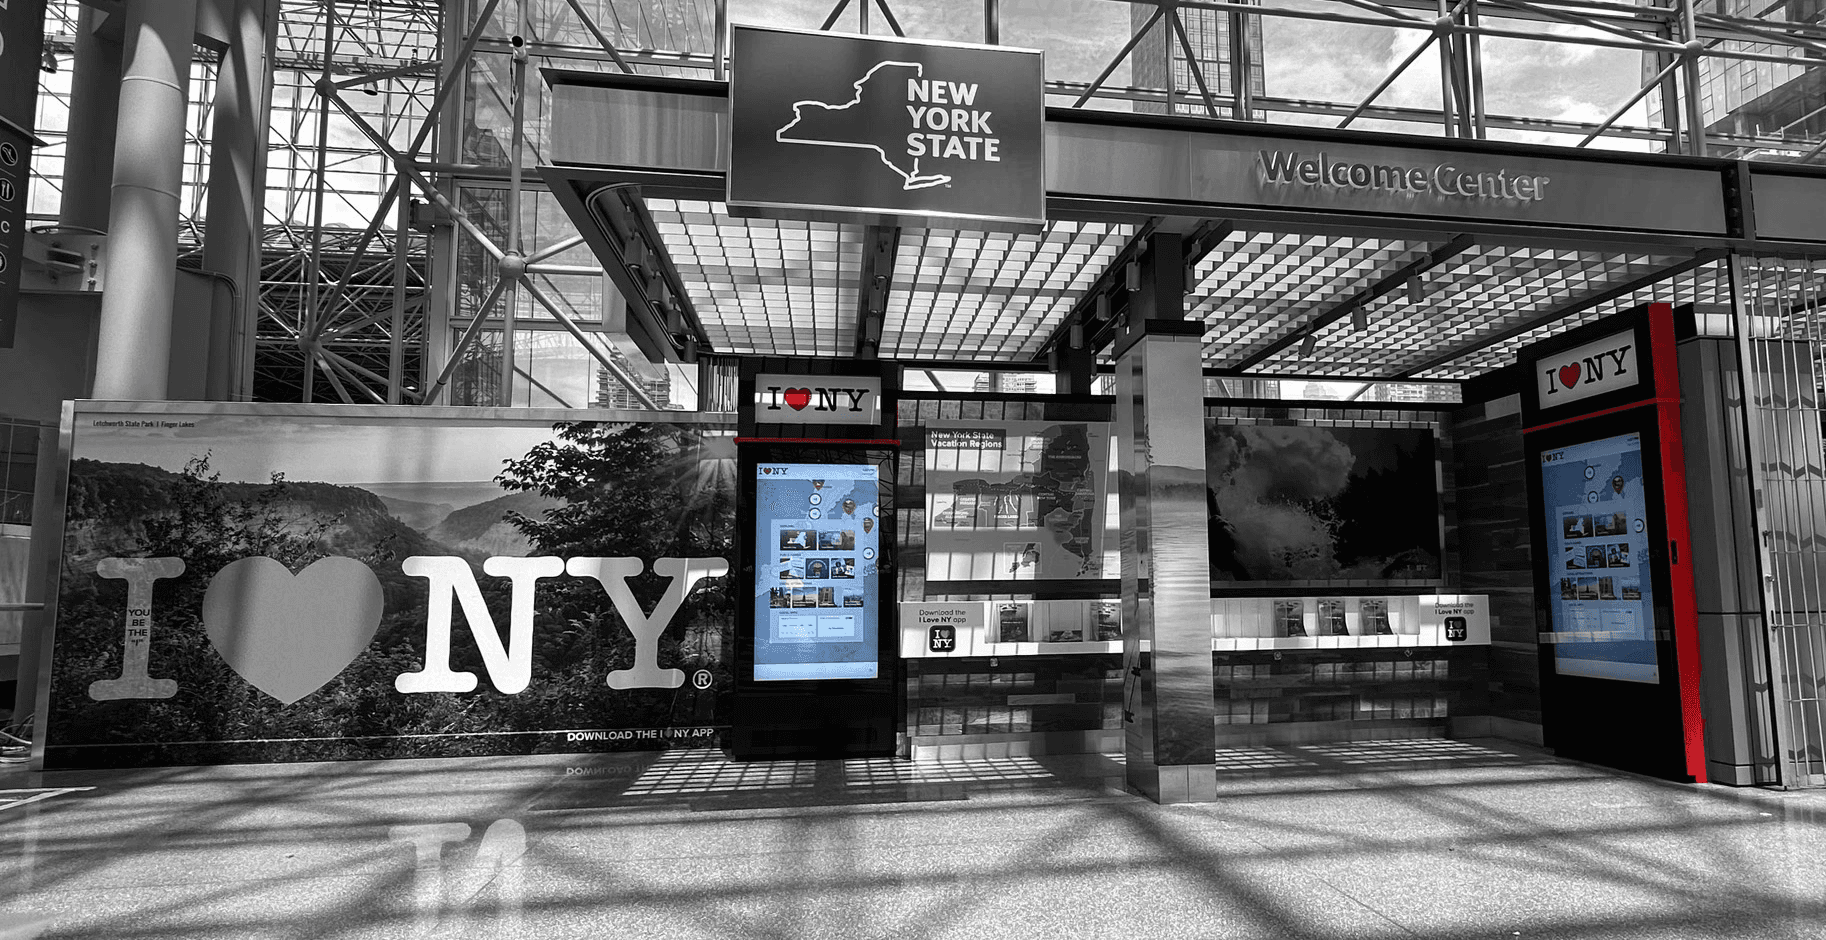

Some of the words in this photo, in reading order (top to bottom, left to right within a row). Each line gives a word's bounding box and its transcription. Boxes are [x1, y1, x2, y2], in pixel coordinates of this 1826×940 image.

[907, 79, 979, 106] NEW
[906, 105, 993, 134] YORK
[906, 132, 1001, 162] STATE
[1258, 150, 1429, 193] Welcome
[1434, 162, 1550, 201] Center
[1545, 368, 1559, 395] I
[1582, 344, 1632, 385] NY
[767, 386, 782, 411] I
[814, 387, 870, 412] NY
[93, 420, 124, 428] Letchworth
[125, 420, 140, 428] State
[141, 420, 154, 428] Park
[161, 421, 178, 429] Finger
[930, 430, 951, 440] New
[952, 431, 971, 440] York
[972, 431, 995, 440] State
[930, 439, 968, 448] Vacation
[969, 439, 1003, 450] Regions
[772, 467, 789, 475] NY
[128, 609, 151, 617] YOU
[131, 619, 146, 627] BE
[953, 617, 967, 625] app
[1448, 621, 1454, 629] I
[88, 557, 187, 702] I
[394, 556, 730, 695] NY
[128, 629, 148, 637] THE
[934, 629, 941, 639] I
[1447, 629, 1464, 637] NY
[932, 638, 953, 649] NY
[567, 730, 633, 741] DOWNLOAD
[635, 729, 658, 740] THE
[673, 728, 690, 739] NY
[691, 728, 714, 737] APP
